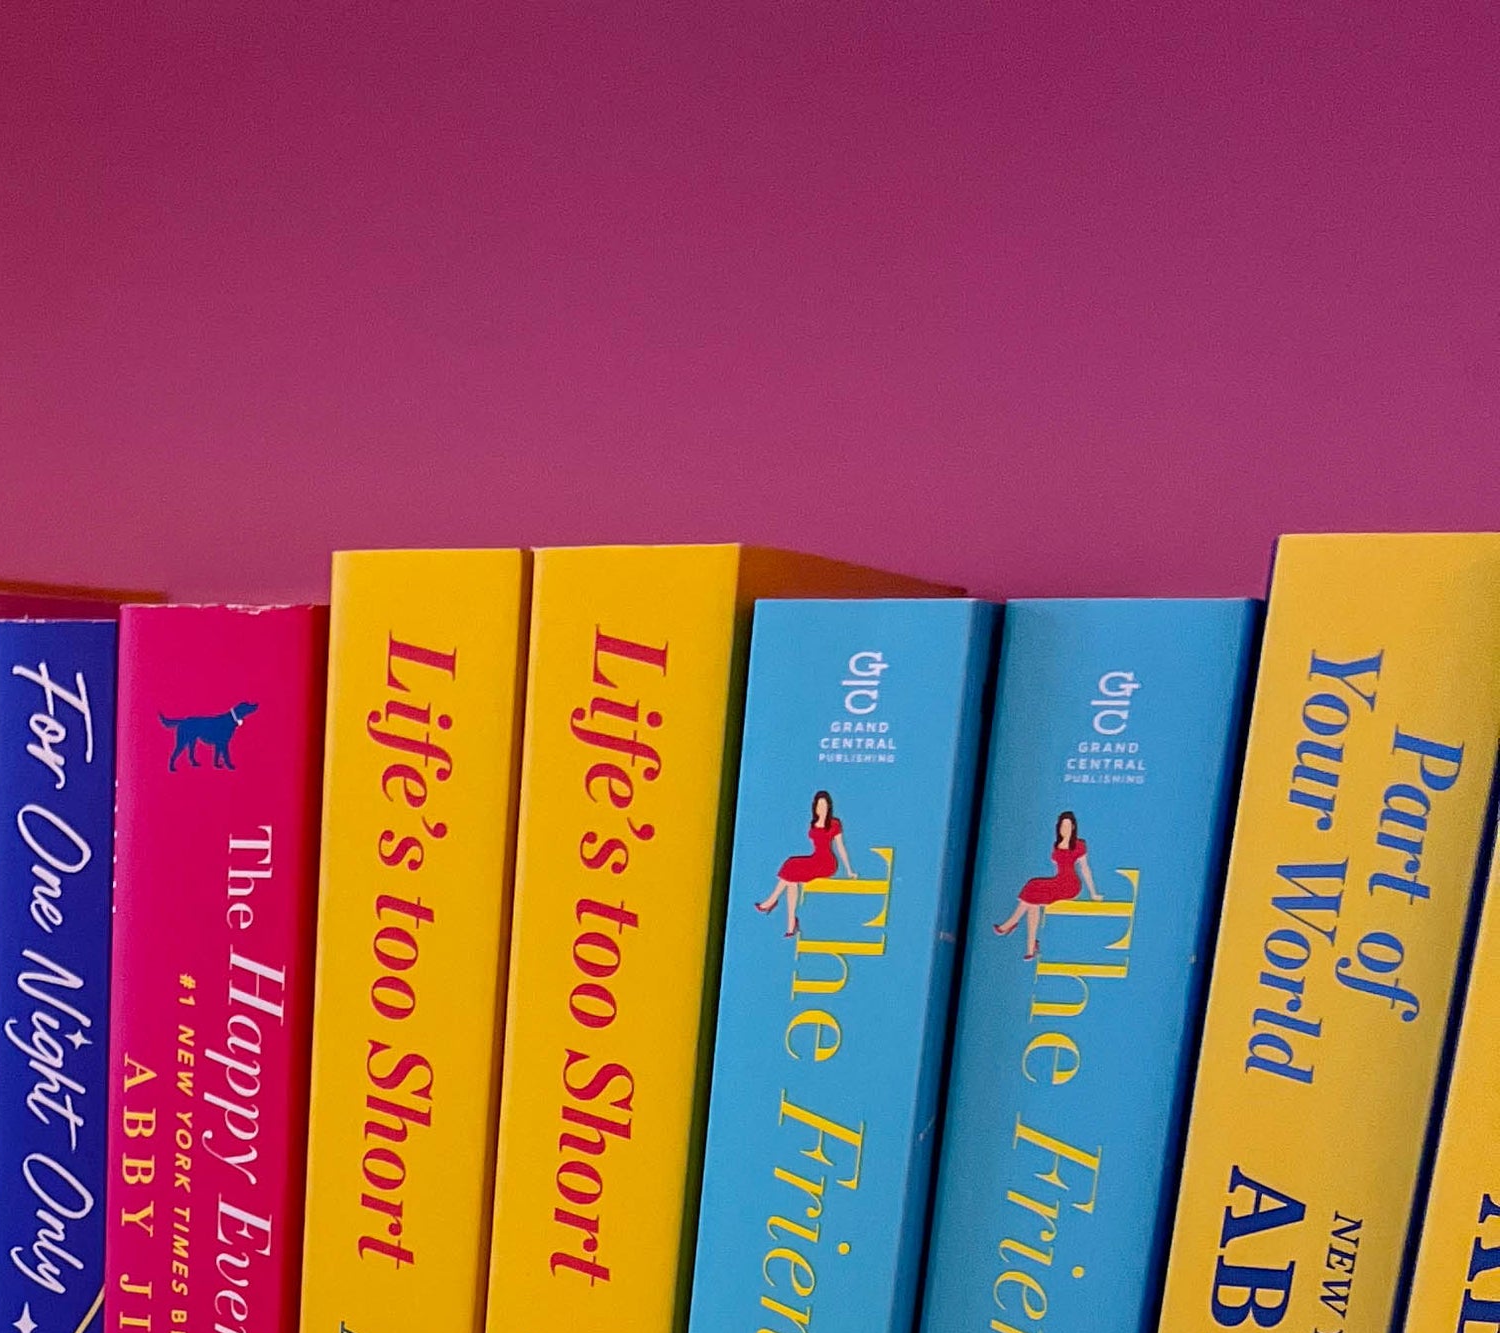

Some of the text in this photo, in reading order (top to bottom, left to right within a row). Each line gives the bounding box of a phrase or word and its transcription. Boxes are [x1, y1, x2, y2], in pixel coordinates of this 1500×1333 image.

[817, 752, 896, 764] PUBLISHING
[819, 737, 897, 750] CENTRAL
[829, 721, 890, 734] GRAND
[1066, 757, 1147, 772] CENTRAL
[1077, 741, 1139, 755] GRAND
[226, 824, 273, 931] The
[1245, 648, 1385, 1085] Your World
[1334, 723, 1466, 1024] Part of
[3, 661, 95, 1295] For One Night Only
[178, 972, 196, 1008] #1
[358, 629, 458, 1271] Life's too Short
[550, 623, 670, 1288] Life's too Short
[784, 846, 894, 1064] The
[1021, 867, 1141, 1086] The
[176, 1024, 196, 1098] NEW
[200, 944, 286, 1186] Happy
[121, 1053, 158, 1238] ABBY
[173, 1110, 194, 1195] YORK
[170, 1206, 191, 1298] TIMES
[1311, 1209, 1365, 1320] NEW
